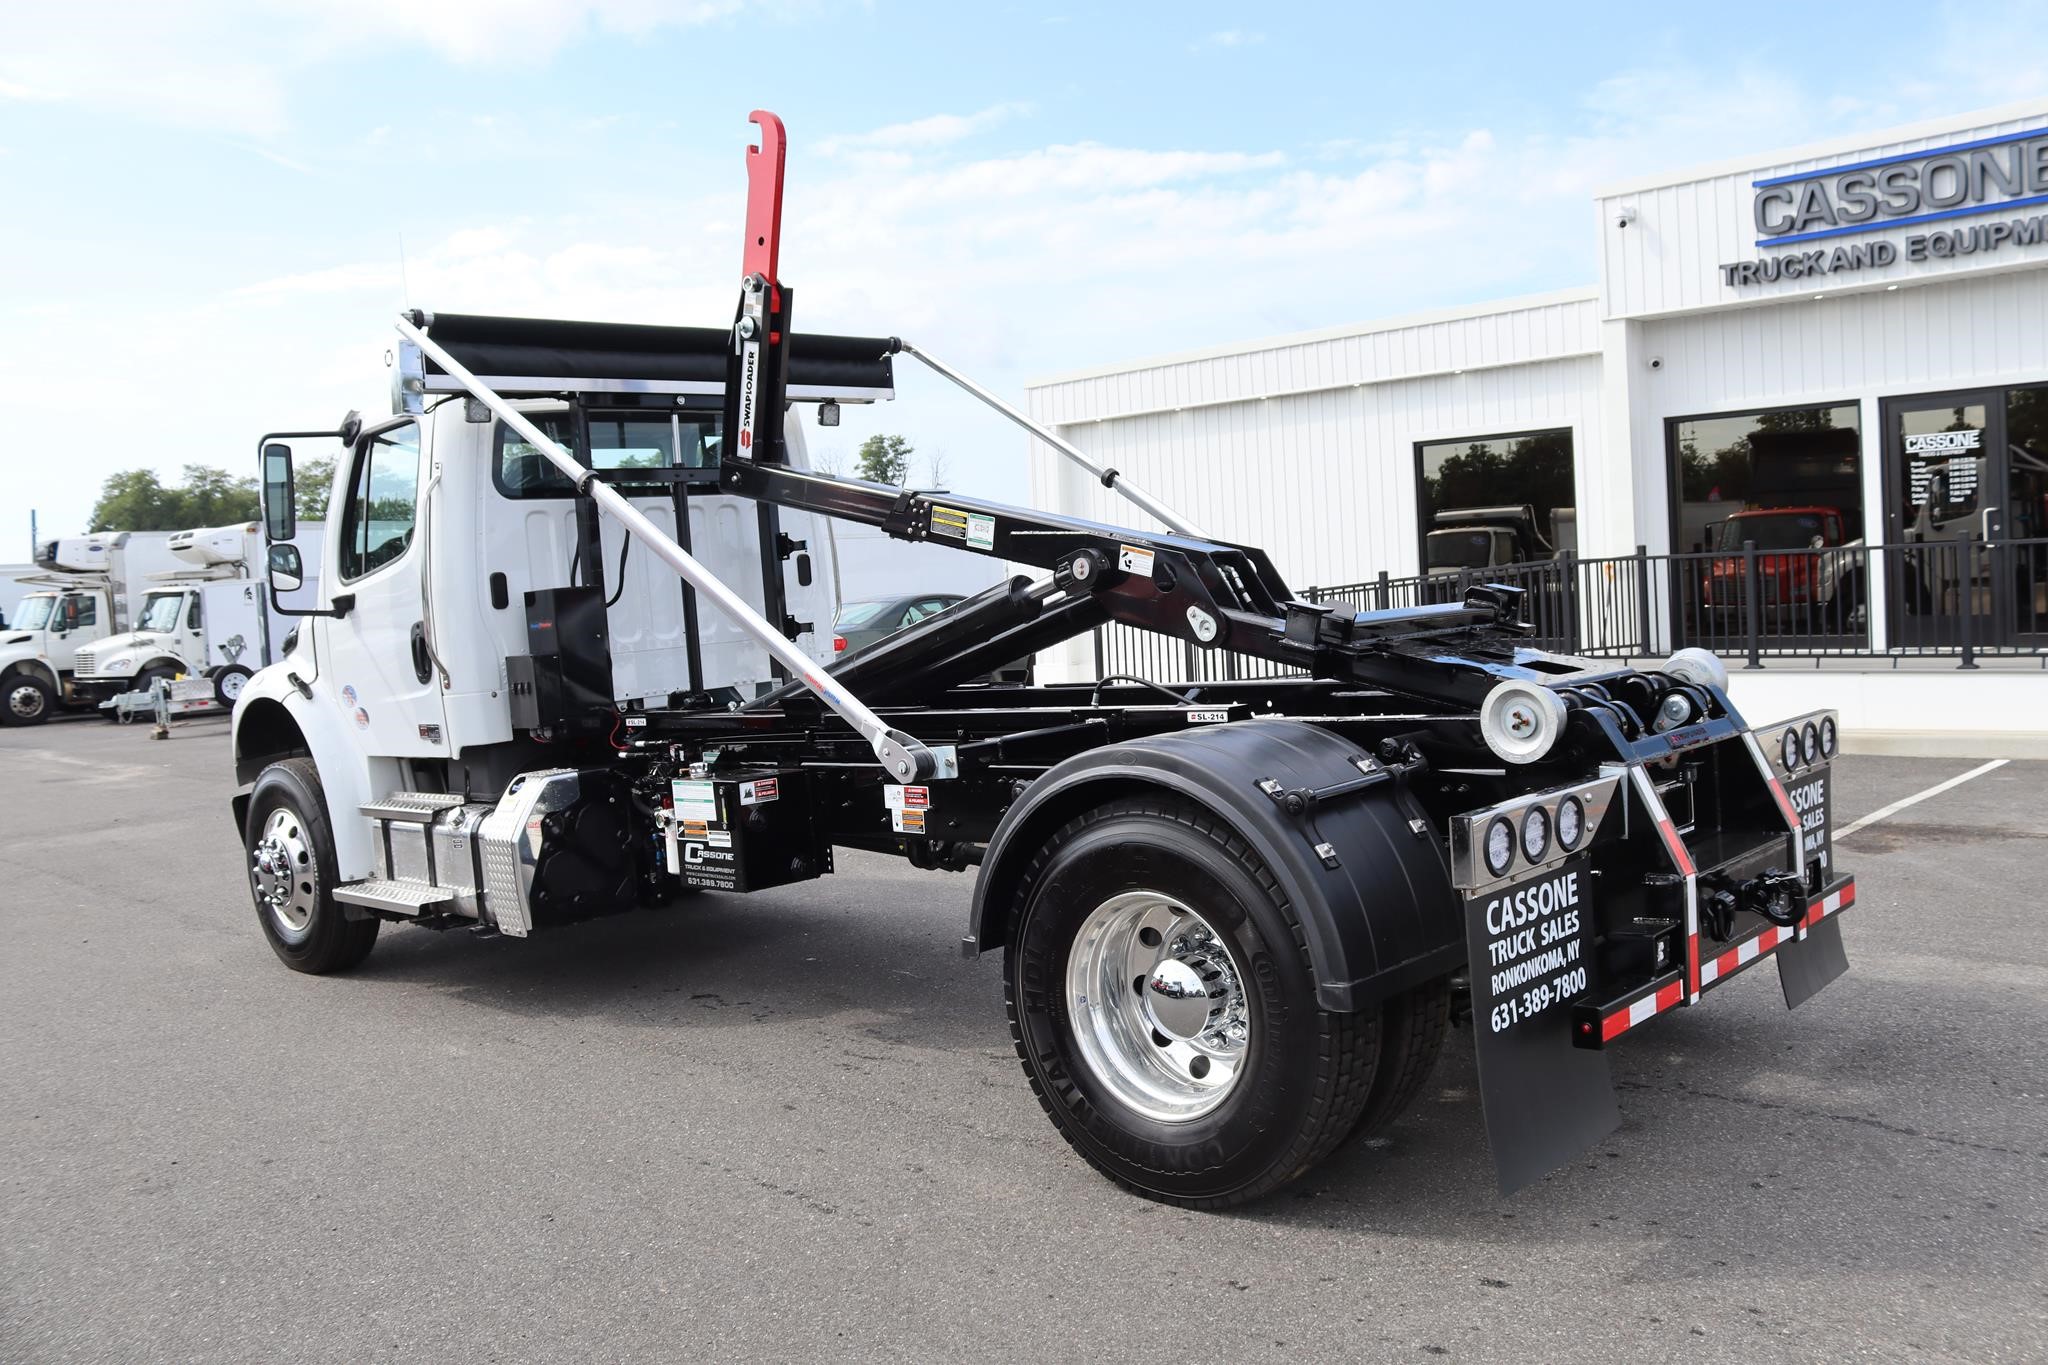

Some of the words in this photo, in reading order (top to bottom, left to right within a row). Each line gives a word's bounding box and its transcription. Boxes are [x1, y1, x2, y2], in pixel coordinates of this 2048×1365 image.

[1754, 139, 2048, 235] CASSONE
[1719, 250, 1828, 287] TRUCK
[1828, 240, 1896, 272] AND
[744, 351, 755, 427] SWAPLOADER
[1906, 432, 1980, 450] CASSONE
[1790, 779, 1824, 813] SSONE
[1803, 807, 1825, 832] SALES
[685, 842, 735, 863] CASSONE
[687, 877, 734, 889] 631.389.7800
[706, 866, 736, 874] EQUIPMENT
[1486, 872, 1579, 936] CASSONE
[1489, 927, 1537, 967] TRUCK
[1541, 910, 1580, 946] SALES
[1567, 938, 1581, 962] NY
[1491, 967, 1587, 1033] 631-389-7800
